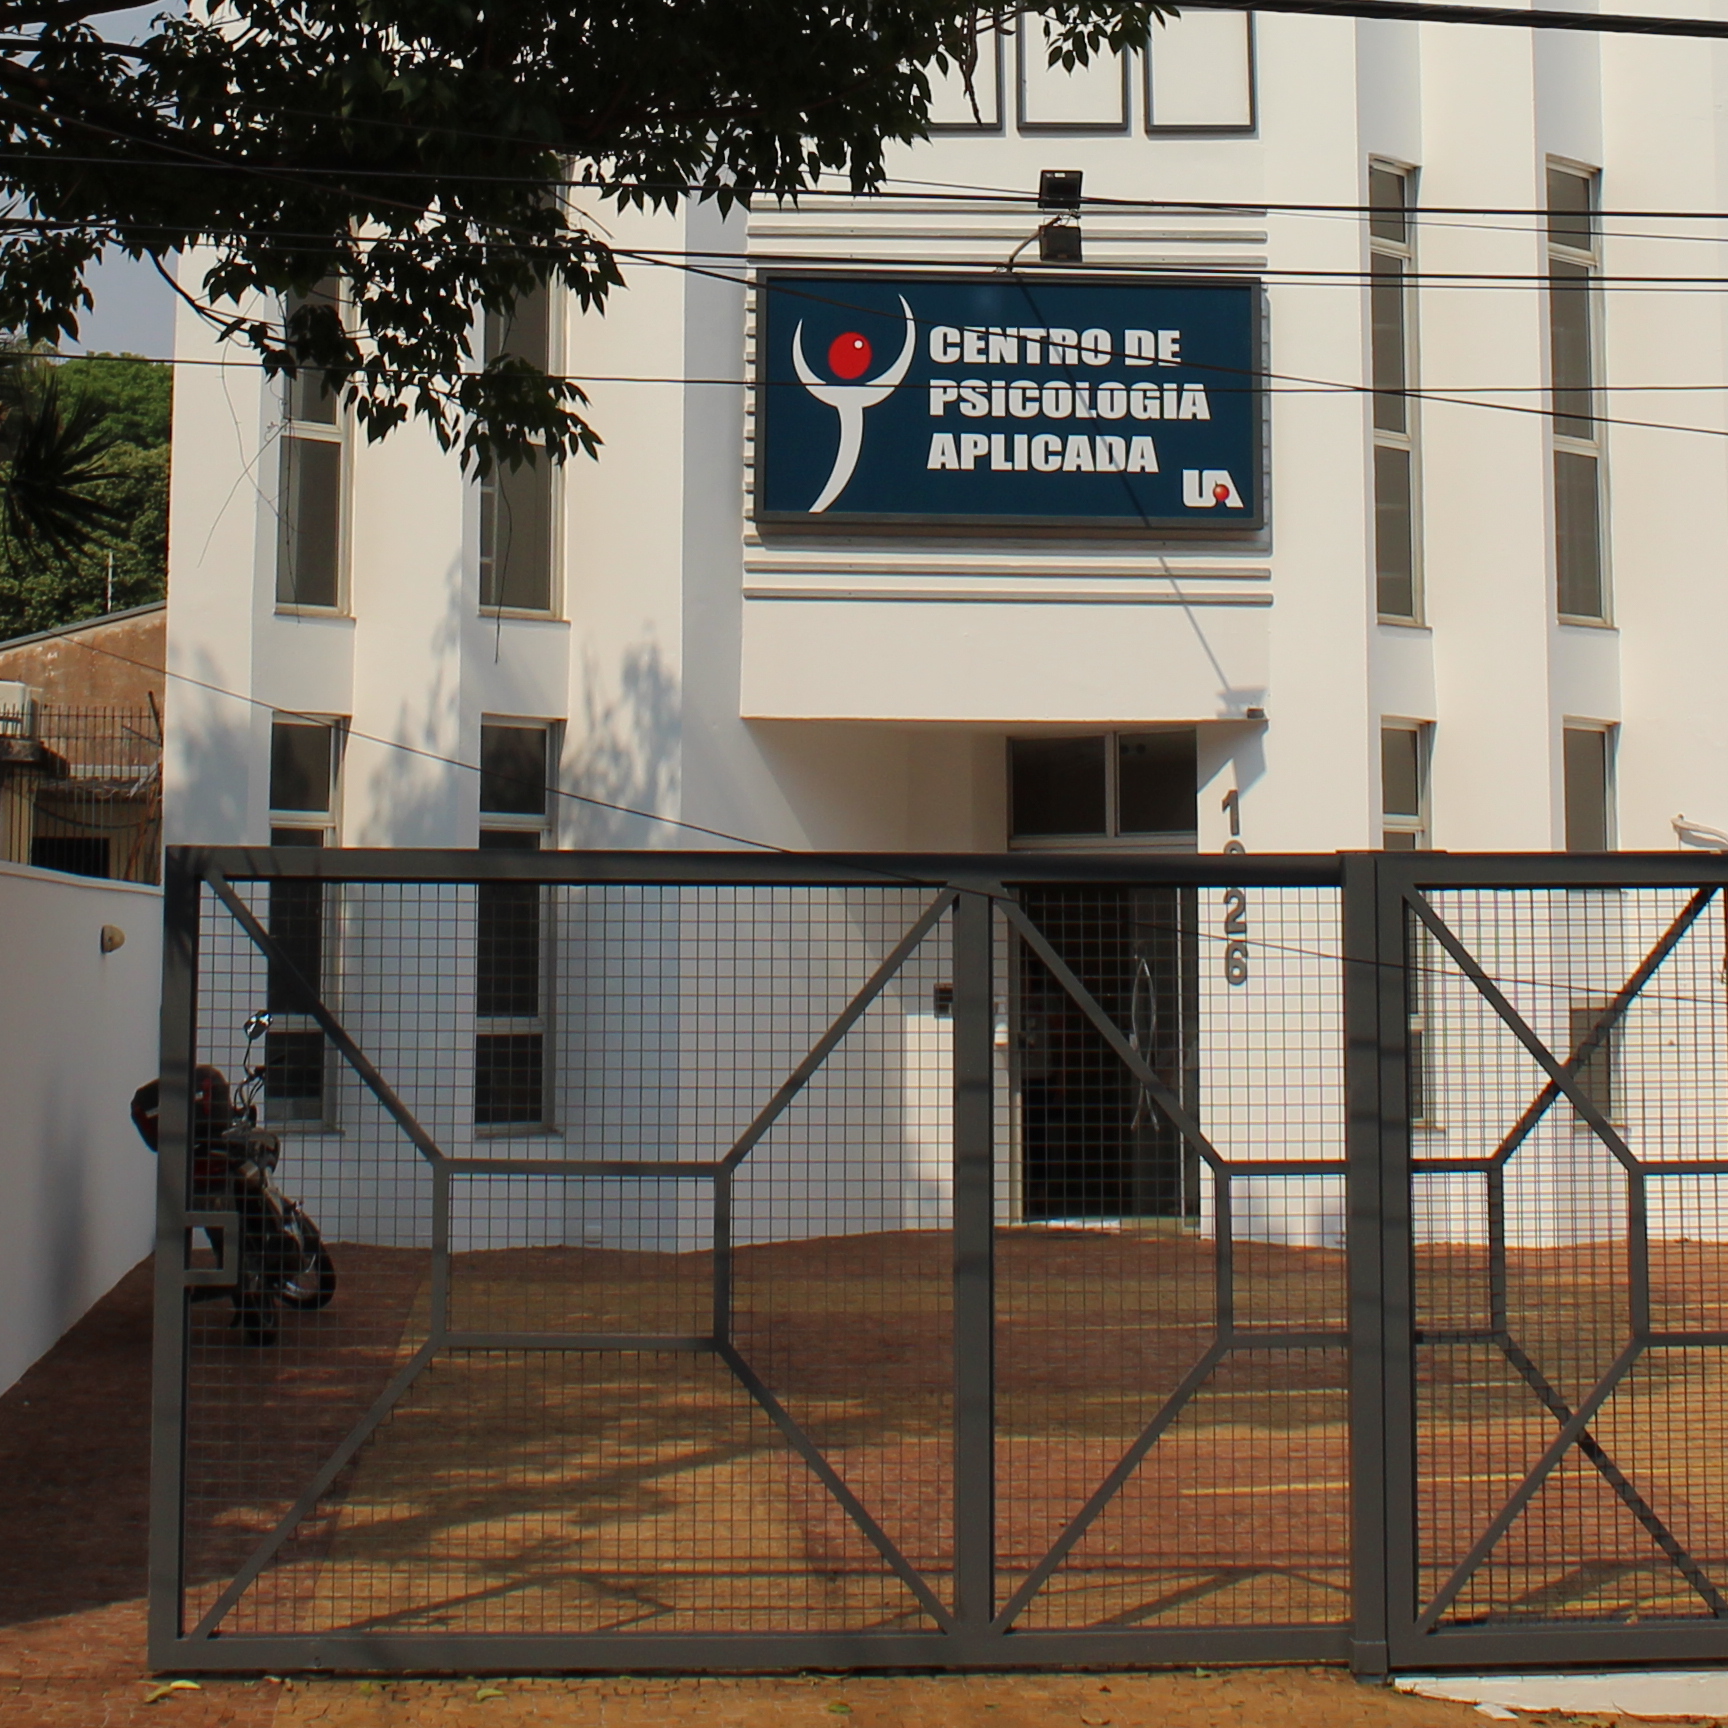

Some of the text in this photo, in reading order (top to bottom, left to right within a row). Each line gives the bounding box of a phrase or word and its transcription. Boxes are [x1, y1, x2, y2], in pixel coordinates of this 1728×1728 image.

[928, 324, 1182, 367] CENTRO DE
[928, 378, 1212, 421] PSICOLOGIA
[926, 432, 1160, 474] APLICADA
